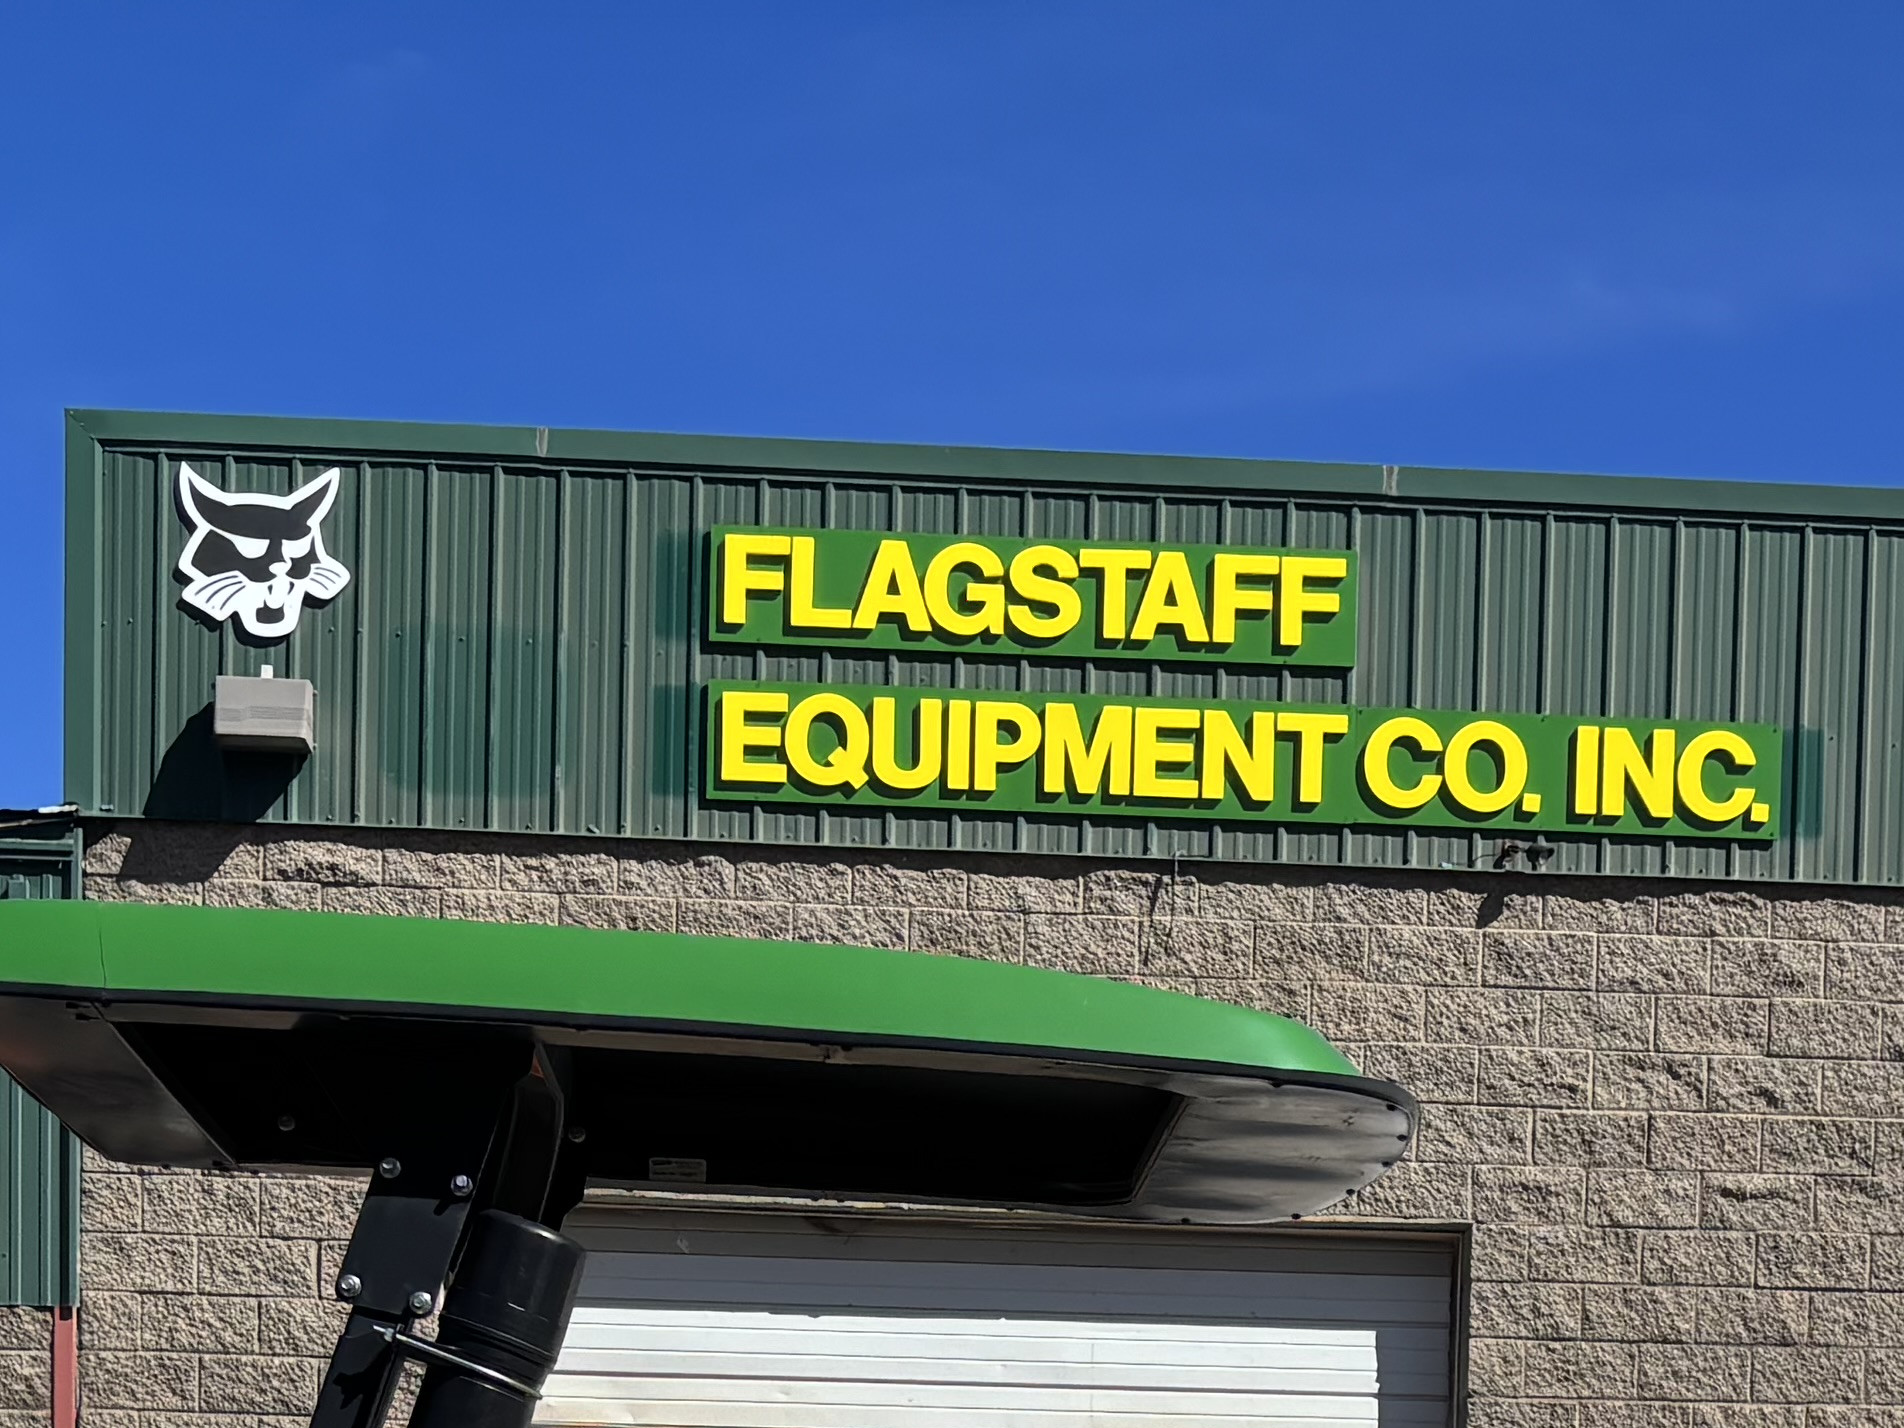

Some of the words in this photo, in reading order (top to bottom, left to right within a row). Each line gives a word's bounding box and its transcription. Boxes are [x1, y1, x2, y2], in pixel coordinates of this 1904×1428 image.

[720, 532, 1349, 648] FLAGSTAFF
[719, 691, 1350, 803] EQUIPMENT
[1363, 716, 1543, 814] CO.
[1574, 724, 1772, 825] INC.
